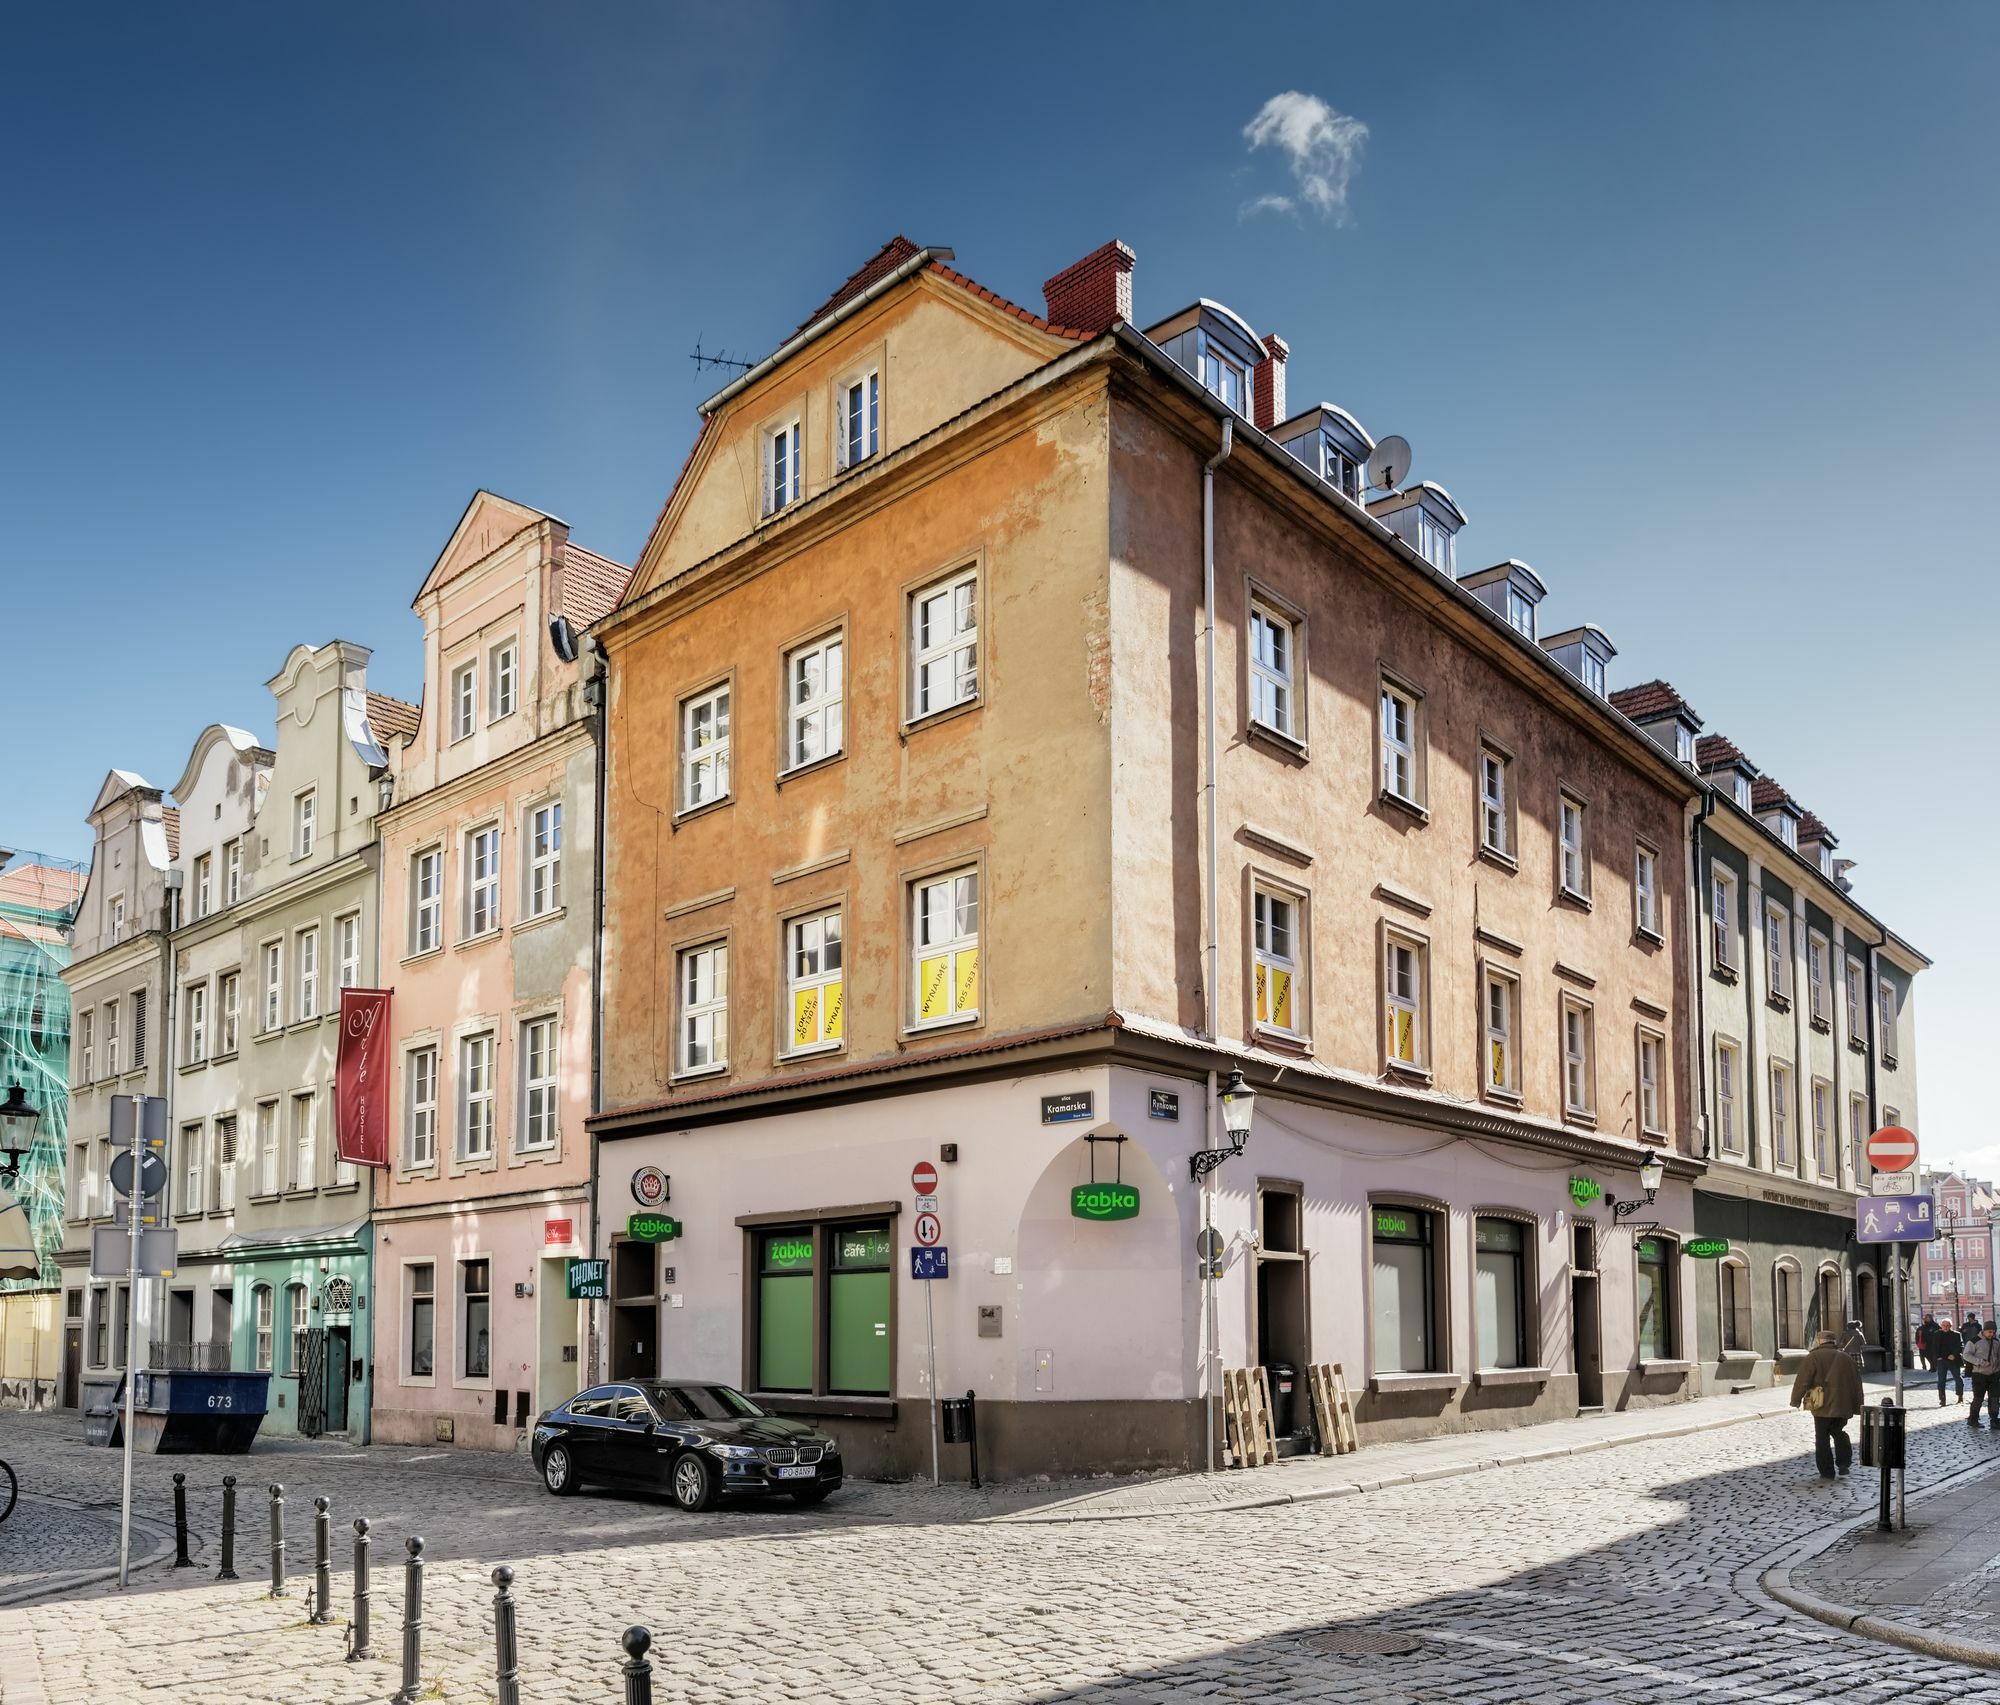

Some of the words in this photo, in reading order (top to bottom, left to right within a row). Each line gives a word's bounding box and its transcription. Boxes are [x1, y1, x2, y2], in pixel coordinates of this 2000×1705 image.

[957, 990, 968, 1009] 605
[965, 970, 976, 990] 583
[796, 998, 813, 1033] LOKALE
[348, 1001, 382, 1083] Arte
[1047, 1101, 1087, 1114] Kramarska
[1152, 1098, 1177, 1112] Rynkowa
[1570, 1175, 1601, 1199] żabka
[1077, 1191, 1135, 1208] żabka
[633, 1218, 673, 1233] żabka
[1376, 1214, 1406, 1232] żabka
[771, 1241, 813, 1260] żabka
[844, 1243, 866, 1257] café
[1690, 1241, 1726, 1252] żabka
[570, 1261, 604, 1289] THONET
[580, 1285, 603, 1297] PUB
[207, 1395, 232, 1408] 673
